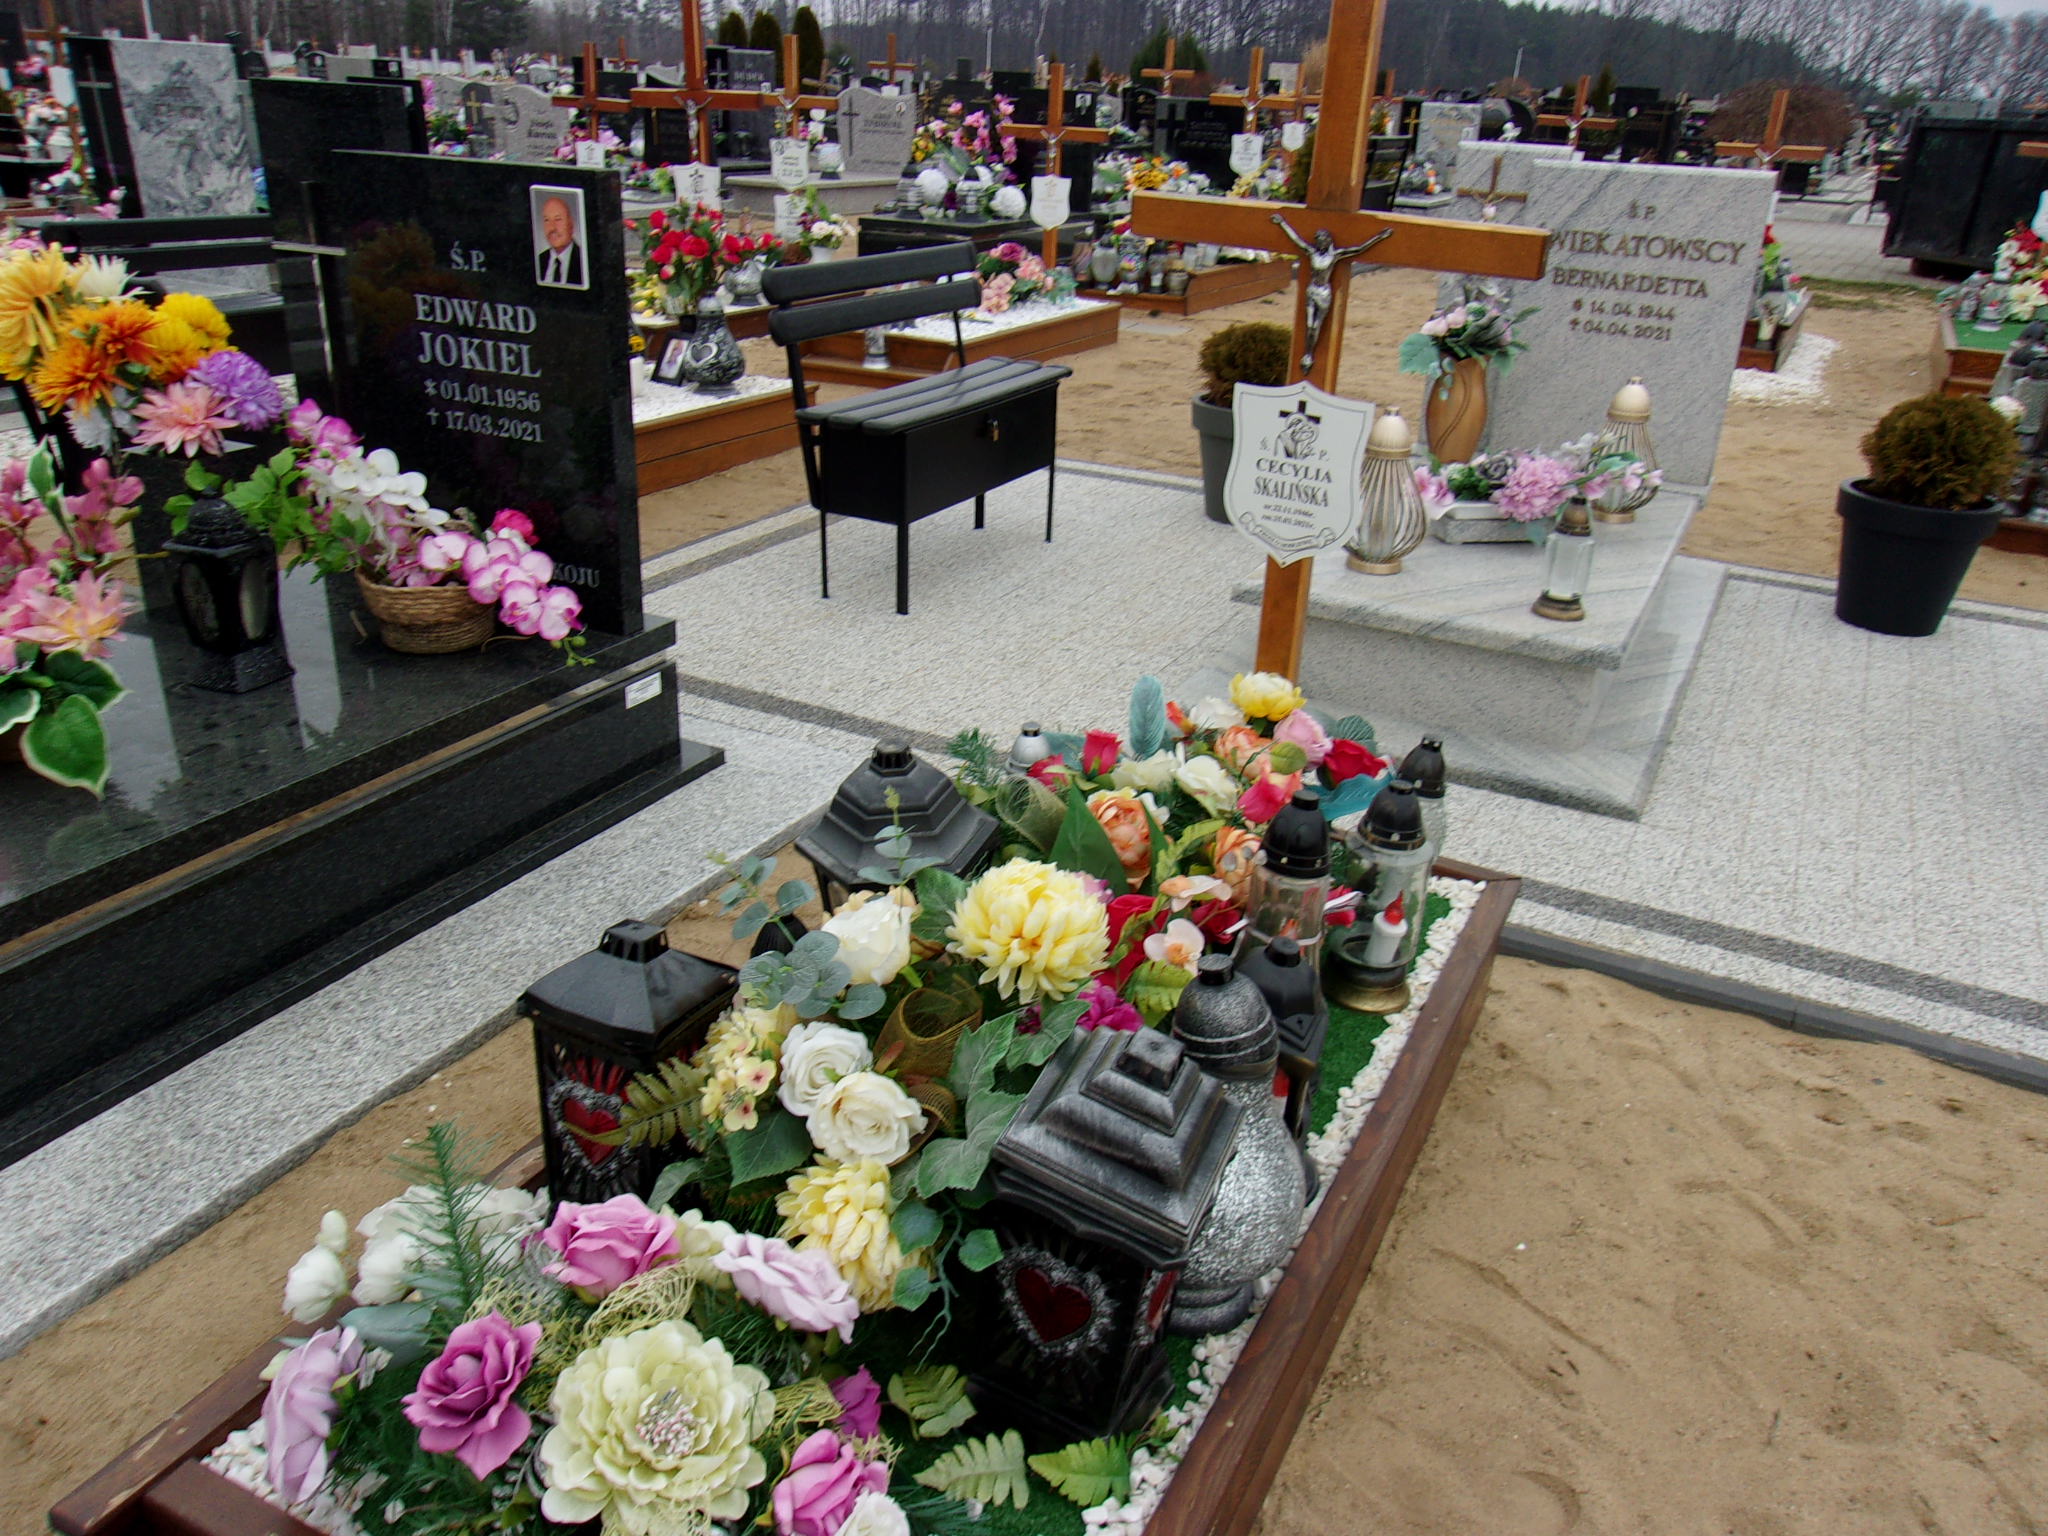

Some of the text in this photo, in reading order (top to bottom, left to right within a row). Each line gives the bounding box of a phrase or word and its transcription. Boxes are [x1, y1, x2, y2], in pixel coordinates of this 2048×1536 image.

[450, 240, 487, 272] Ś.P.
[1550, 228, 1746, 265] WIEKATOWSCY
[1552, 267, 1708, 297] BERNARDETTA
[414, 293, 537, 334] EDWARD
[418, 331, 542, 378] JOKIEL
[440, 379, 541, 412] 01.01.1956
[446, 411, 544, 443] 17.03.2021
[1256, 458, 1332, 483] CECYLIA
[552, 563, 600, 588] KOJU
